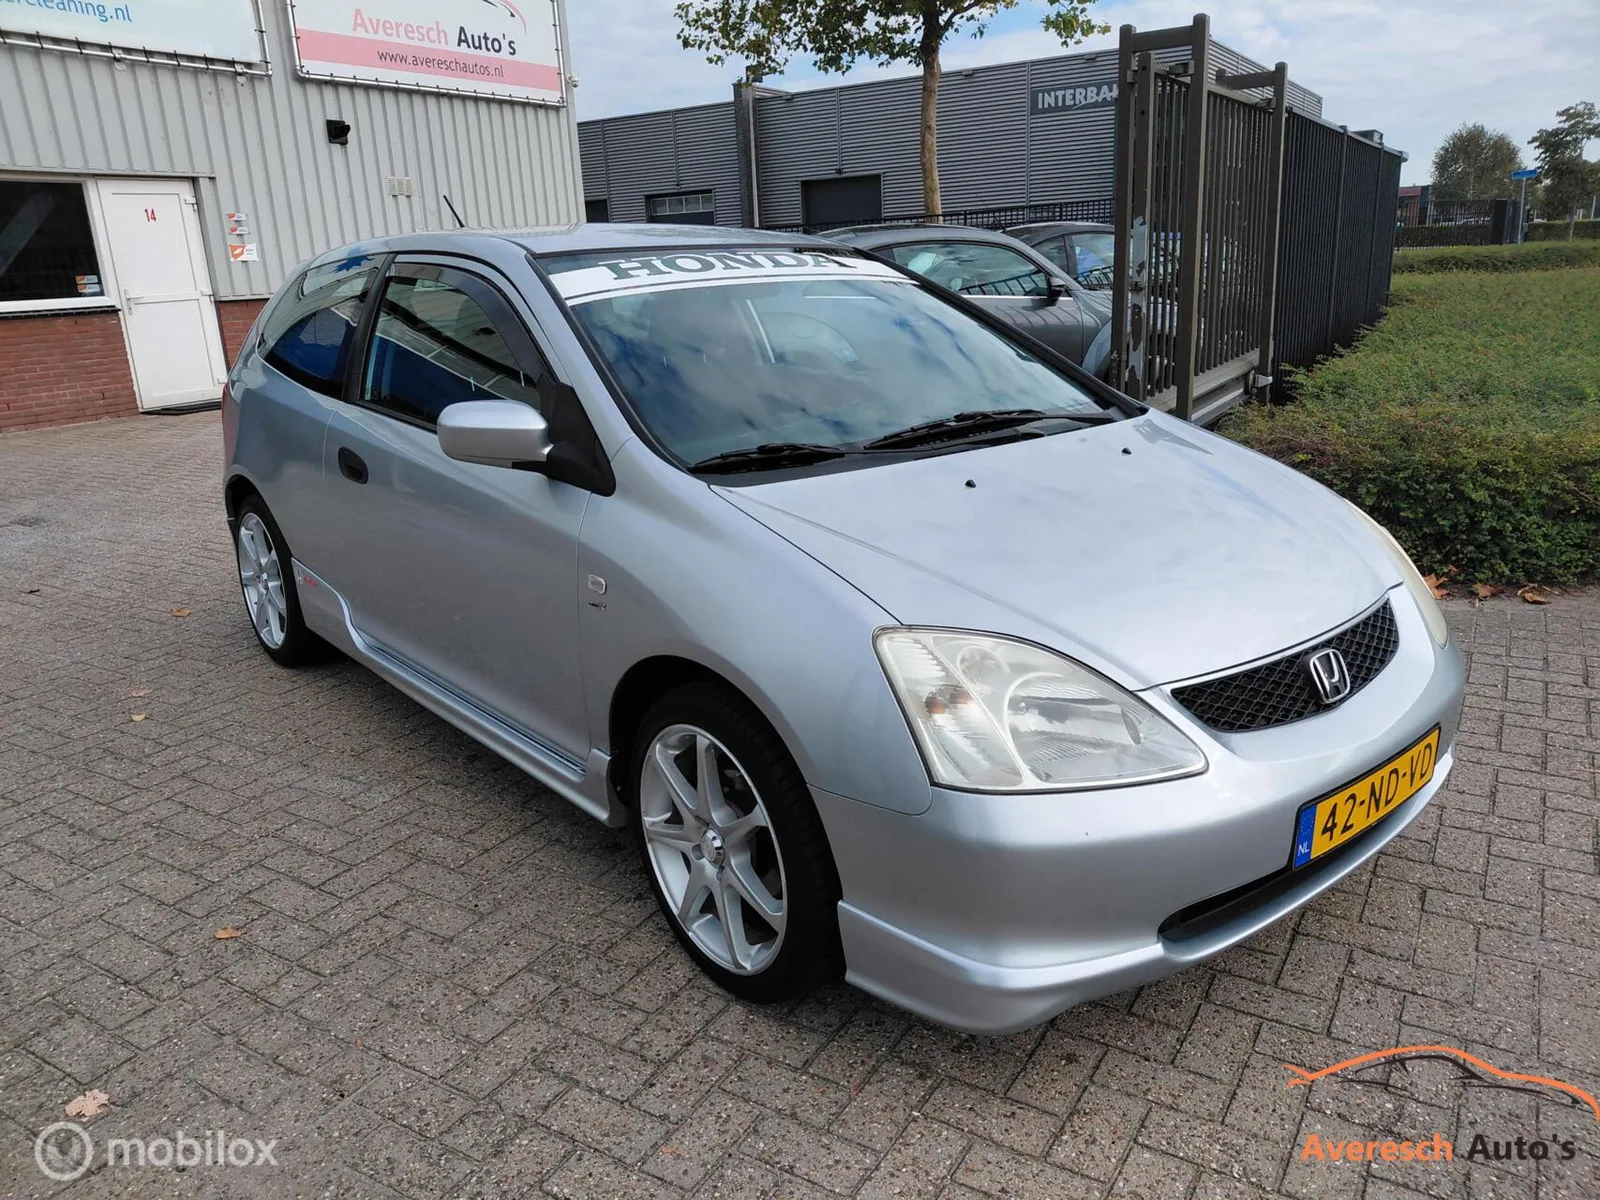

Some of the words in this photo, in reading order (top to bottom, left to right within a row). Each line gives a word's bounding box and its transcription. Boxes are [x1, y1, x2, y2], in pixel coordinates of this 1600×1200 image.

[0, 0, 132, 22] eaning.nl
[352, 8, 449, 46] Averesch
[456, 26, 517, 56] Auto's
[377, 50, 504, 78] www.avereschautos.nl
[144, 208, 157, 222] 14
[598, 251, 858, 280] HONDA
[1321, 742, 1433, 841] 42-ND-VD
[1297, 842, 1310, 856] NL
